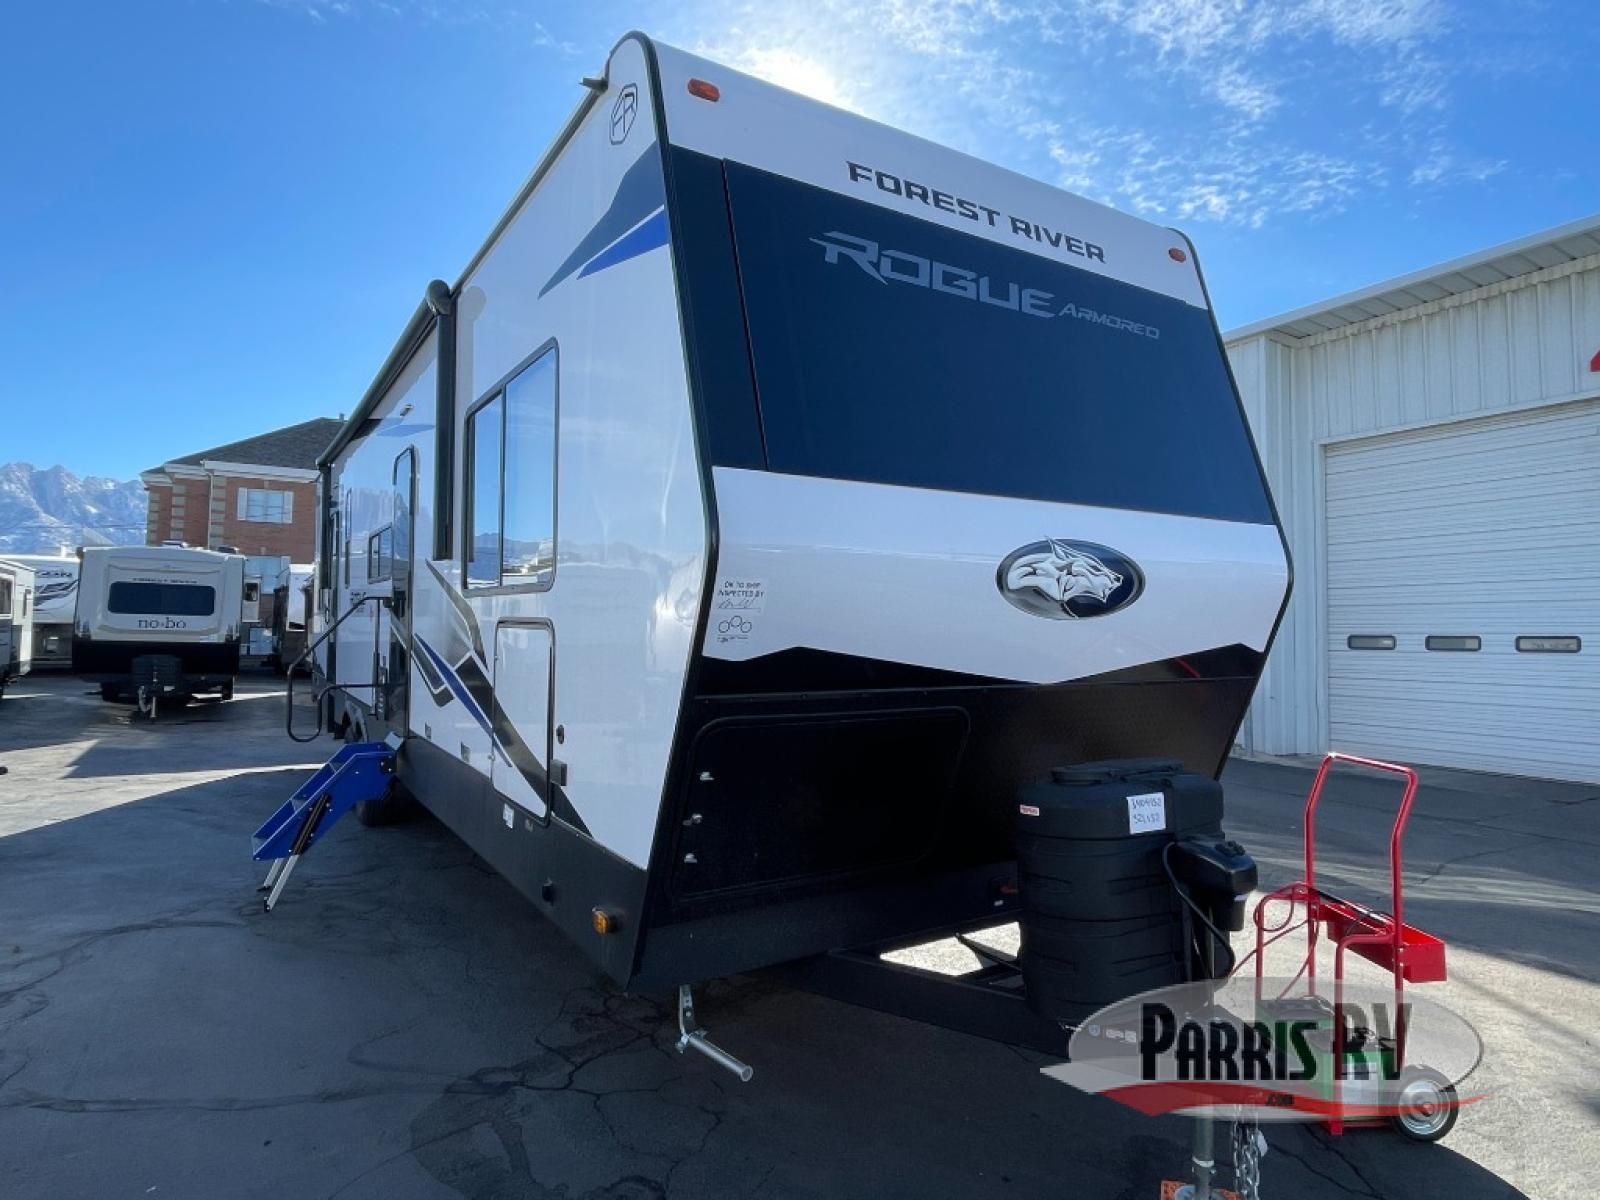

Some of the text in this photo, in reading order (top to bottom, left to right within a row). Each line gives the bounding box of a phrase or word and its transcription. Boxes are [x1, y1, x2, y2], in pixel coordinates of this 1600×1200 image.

[846, 160, 1106, 264] FOREST RIVER
[808, 231, 1161, 341] ROGUE ARMORED
